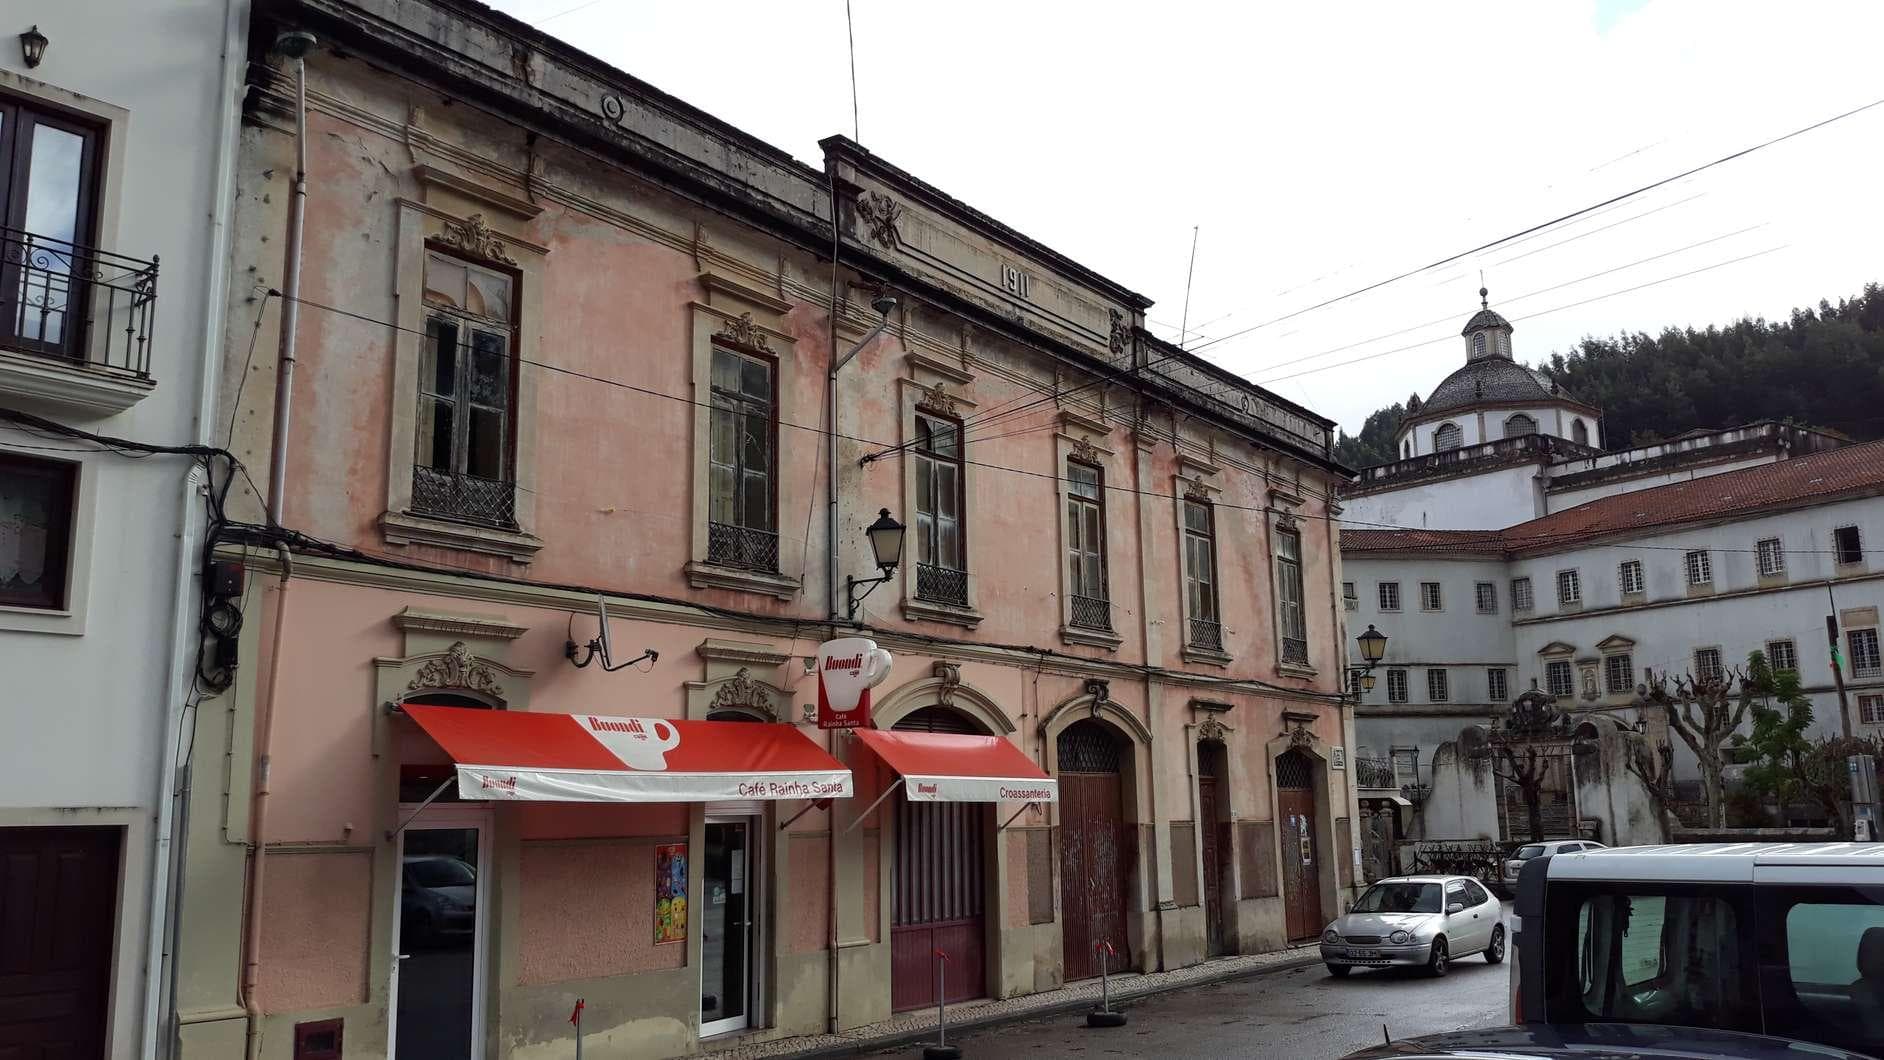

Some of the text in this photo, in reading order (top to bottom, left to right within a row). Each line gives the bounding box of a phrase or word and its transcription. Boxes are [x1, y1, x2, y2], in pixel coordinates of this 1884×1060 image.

[1001, 264, 1029, 298] 1911
[825, 653, 863, 671] Buondi
[588, 716, 645, 733] Buondi
[482, 775, 517, 789] Buondi
[738, 780, 844, 796] Café Rainha Santa
[1000, 786, 1052, 799] Croassanteria
